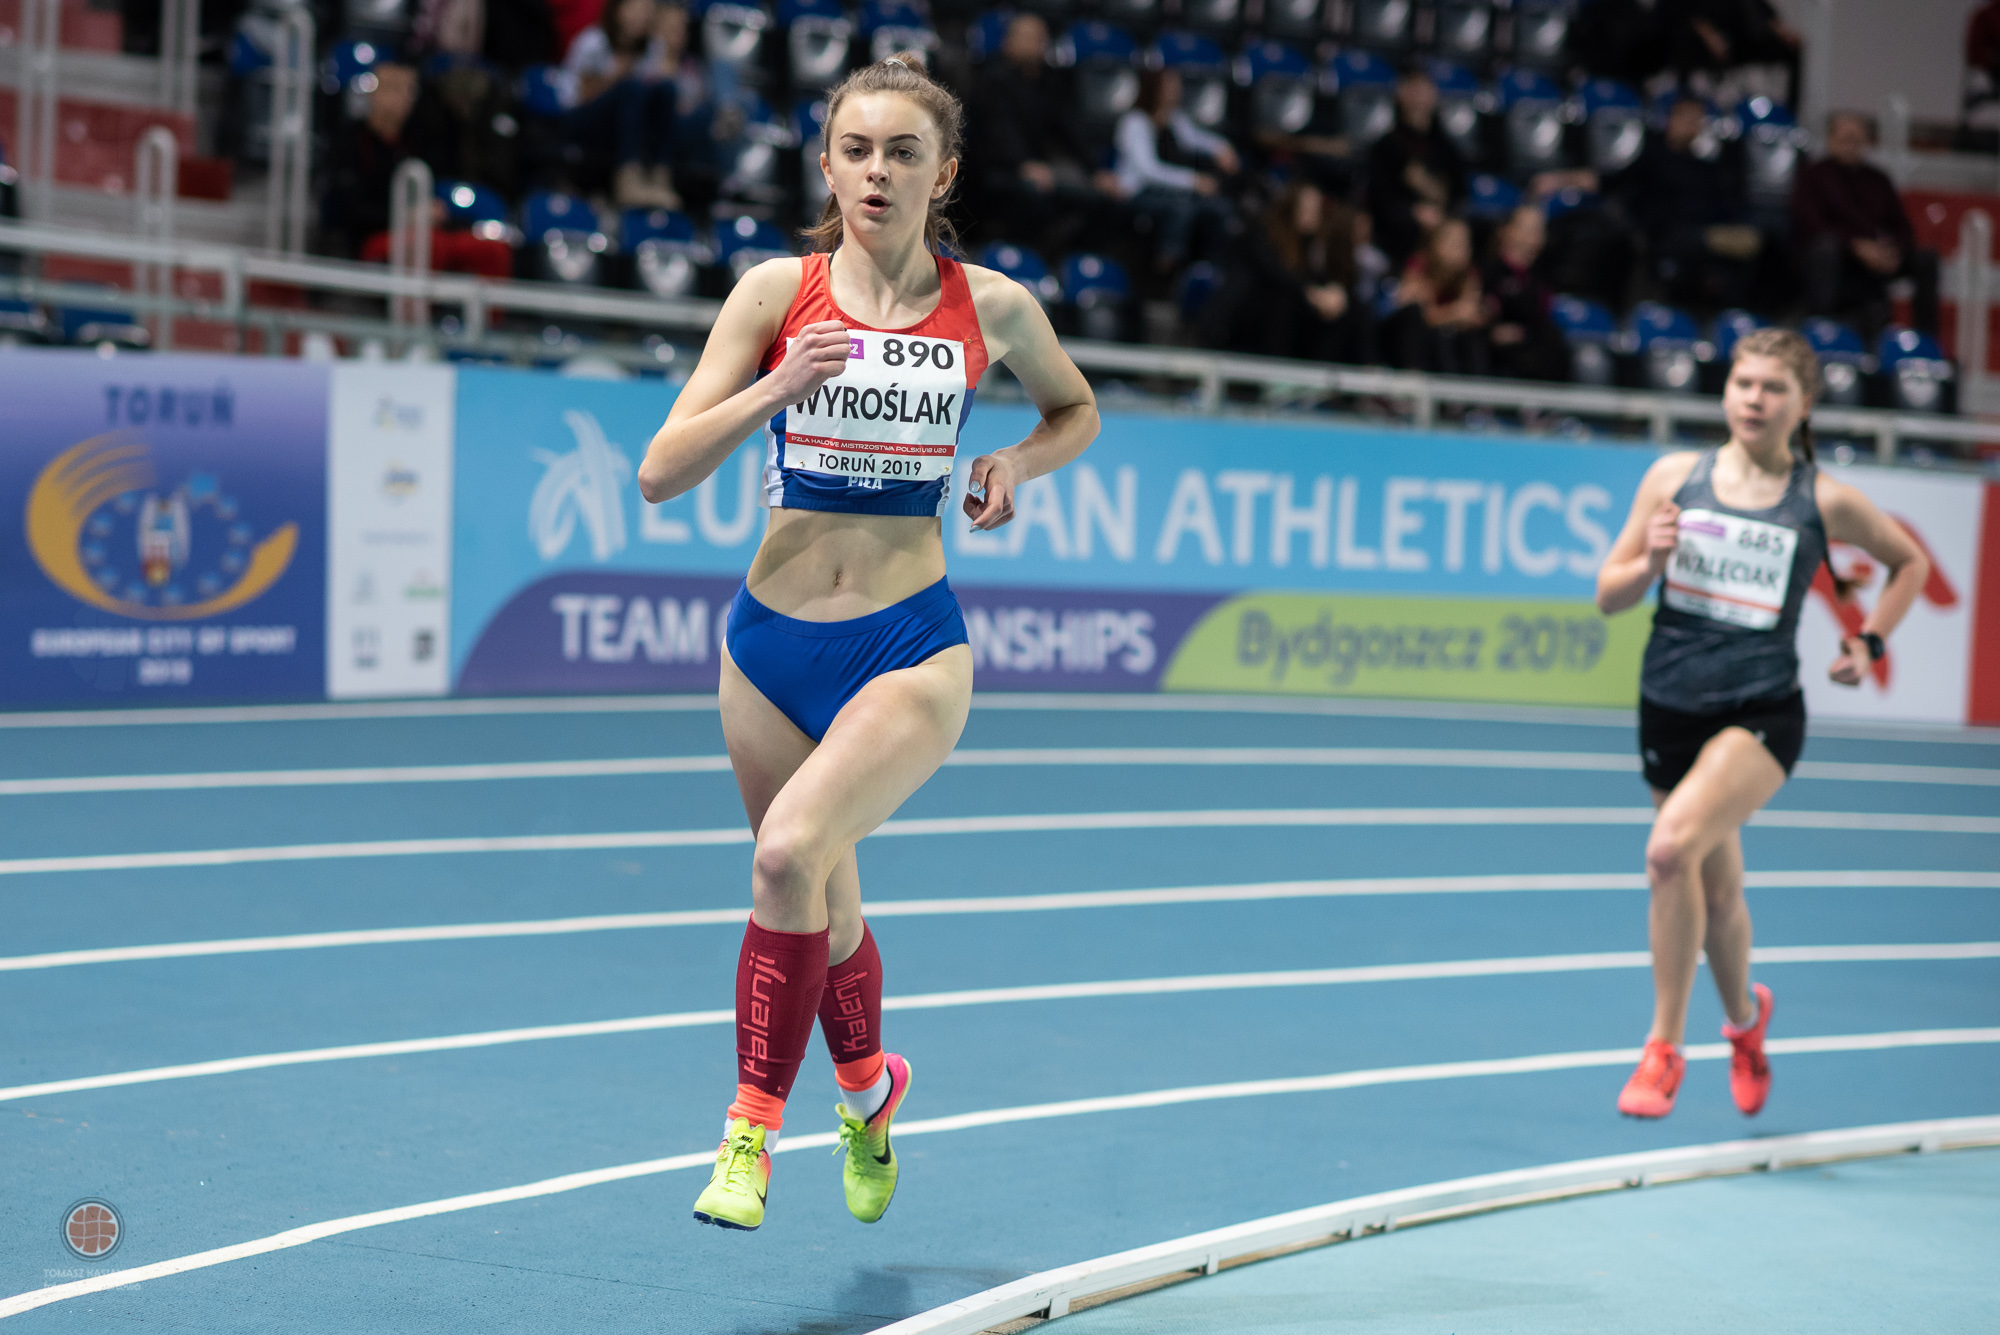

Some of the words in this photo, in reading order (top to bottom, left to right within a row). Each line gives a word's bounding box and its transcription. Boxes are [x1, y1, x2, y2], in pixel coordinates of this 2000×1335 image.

[882, 338, 954, 370] 890
[811, 438, 840, 448] HALOWE
[840, 443, 894, 452] MISTRZOSTWA
[818, 453, 876, 473] TORUŃ
[881, 459, 922, 476] 2019
[1154, 467, 1613, 579] ATHLETICS
[552, 593, 710, 664] TEAM
[1236, 606, 1486, 687] Bydgoszcz
[1494, 613, 1609, 673] 2019
[742, 951, 787, 1078] kalenji
